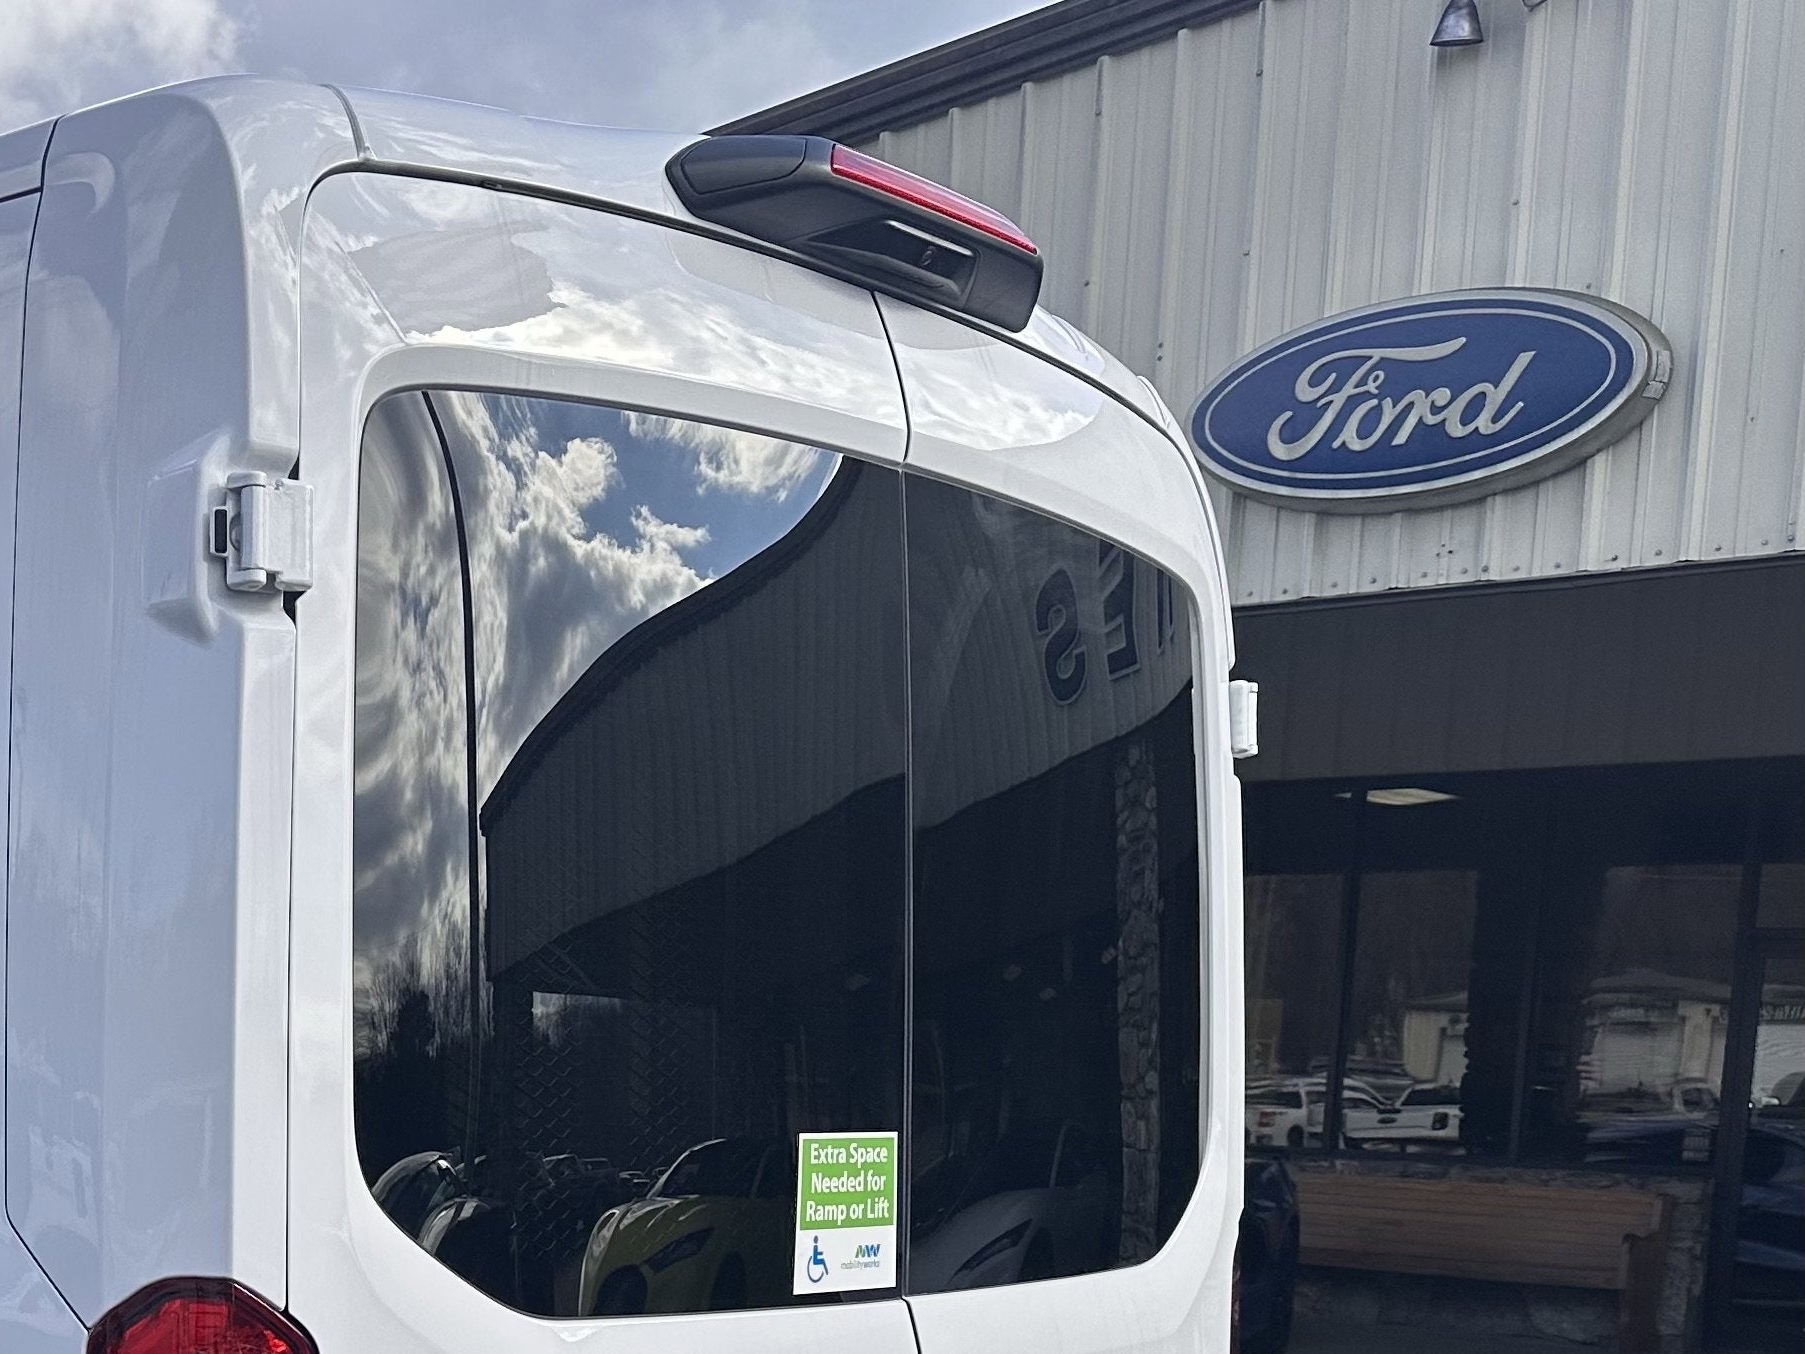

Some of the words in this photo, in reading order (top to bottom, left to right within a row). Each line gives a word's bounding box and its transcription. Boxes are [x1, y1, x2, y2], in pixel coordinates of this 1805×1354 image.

[1267, 337, 1537, 460] Ford
[810, 1143, 847, 1165] Extra
[849, 1142, 888, 1168] Space
[811, 1171, 865, 1194] Needed
[867, 1169, 886, 1191] for
[806, 1201, 847, 1225] Ramp
[849, 1203, 865, 1219] or
[867, 1197, 889, 1219] Lift
